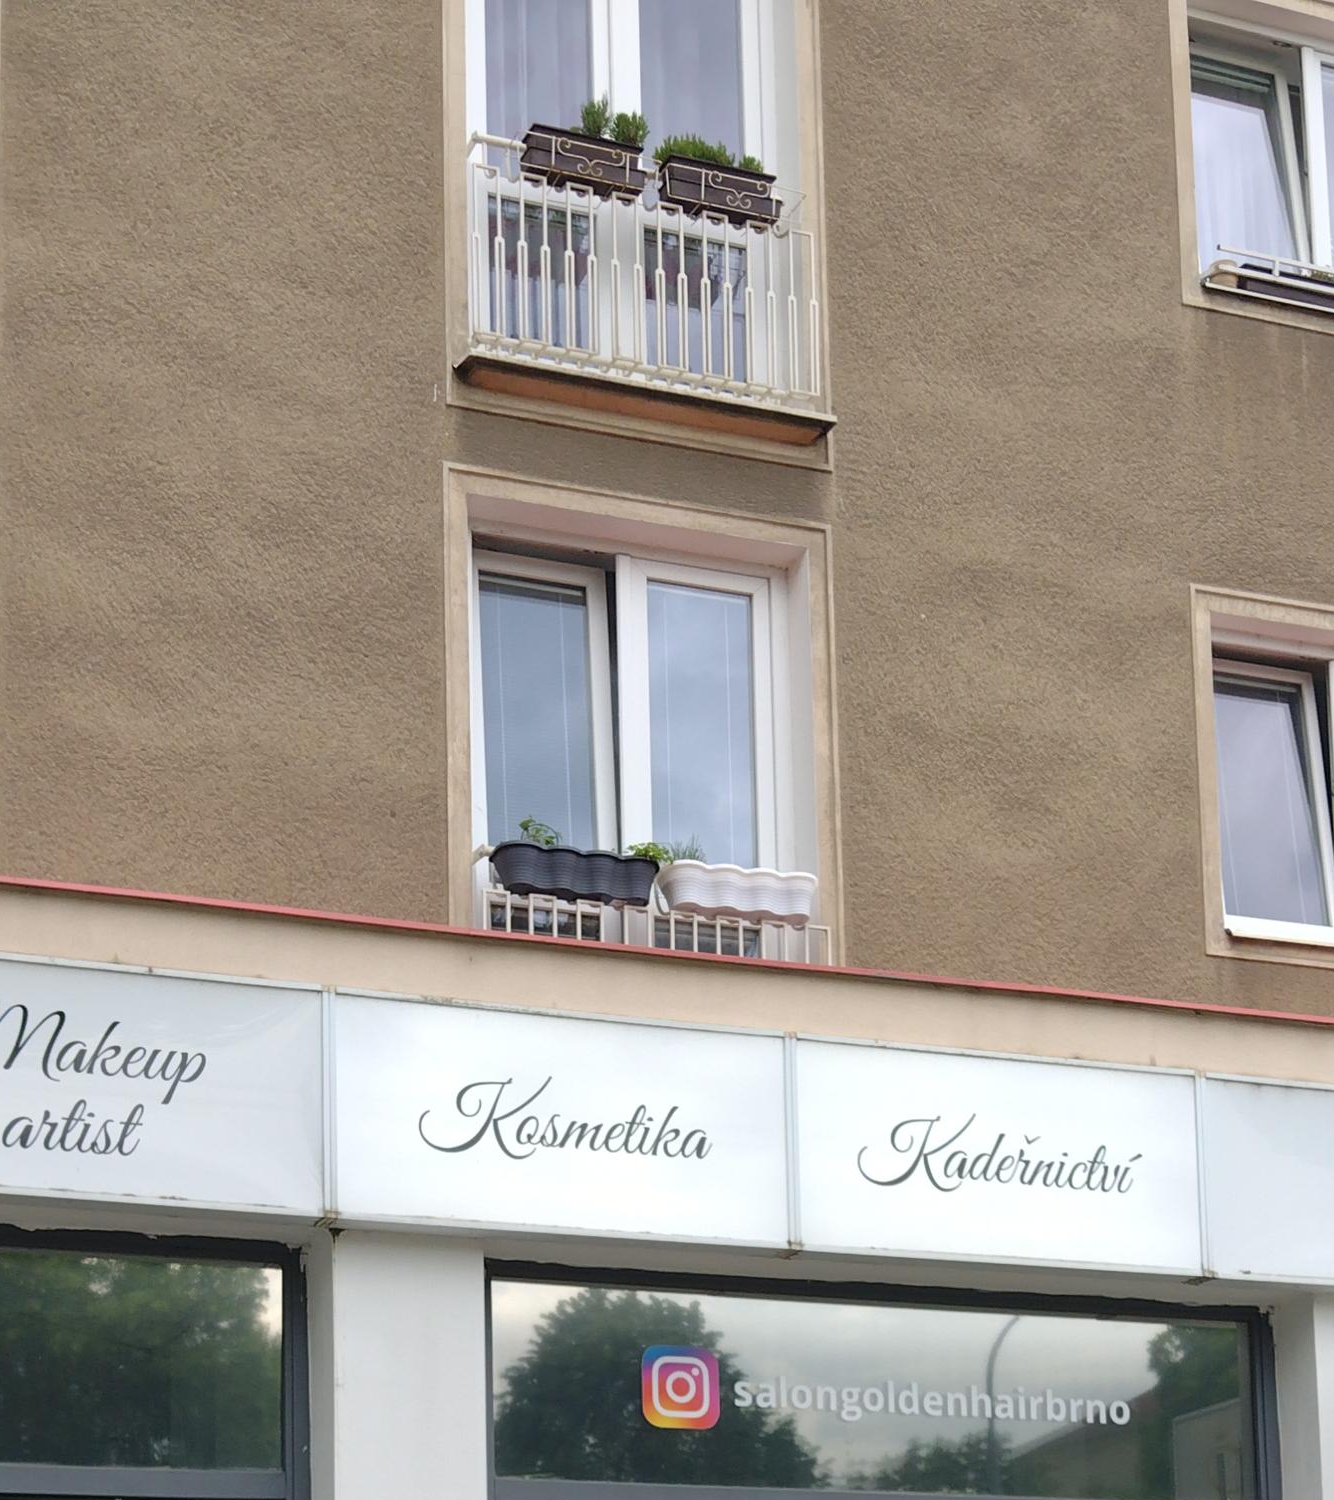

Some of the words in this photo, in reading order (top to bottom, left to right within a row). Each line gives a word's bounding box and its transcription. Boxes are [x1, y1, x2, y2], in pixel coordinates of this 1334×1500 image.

[2, 1099, 144, 1156] artist
[418, 1075, 713, 1160] Kosmetika
[858, 1113, 1143, 1194] Kadeřnictví
[733, 1375, 1132, 1427] salongoldenhairbrno
